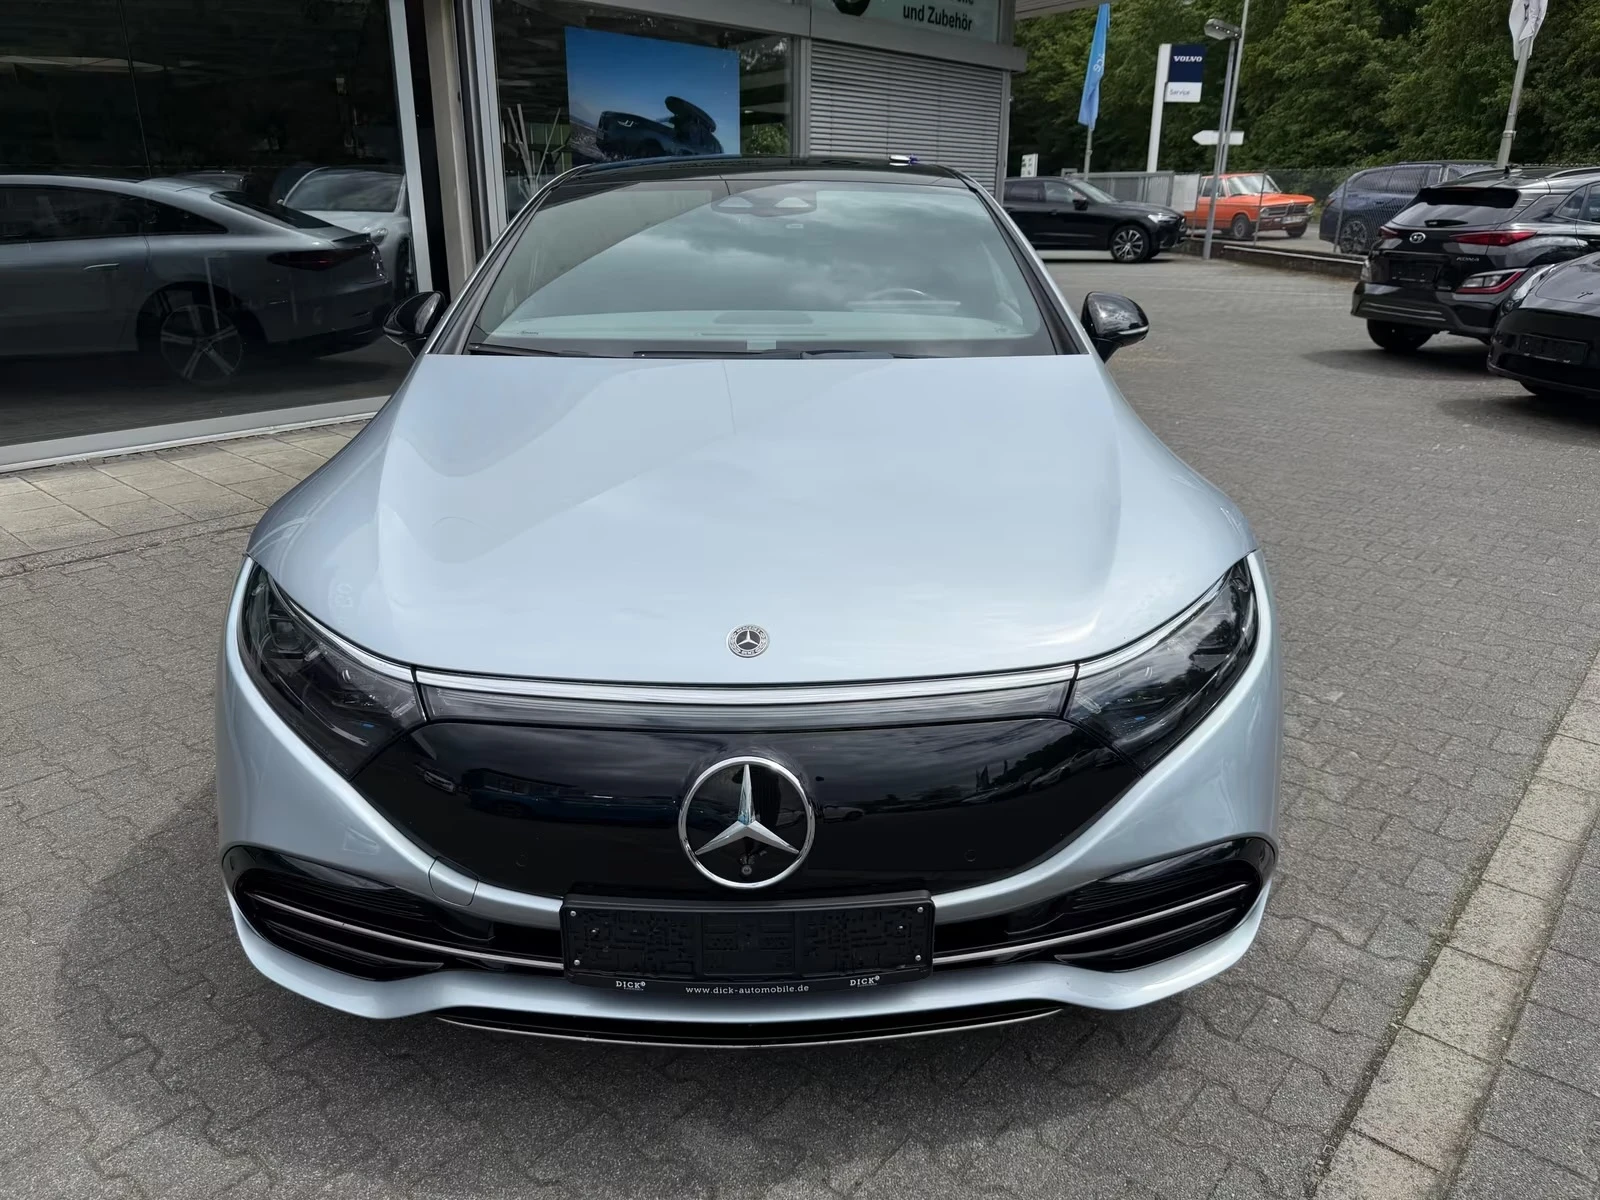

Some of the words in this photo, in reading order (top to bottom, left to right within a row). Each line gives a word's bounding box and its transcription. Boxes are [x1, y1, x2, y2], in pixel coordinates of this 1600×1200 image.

[903, 5, 925, 22] und
[927, 6, 973, 31] Zubehör
[1173, 55, 1203, 63] VOLVO
[1169, 88, 1191, 96] Service
[685, 983, 810, 995] www.dick-automobile.de
